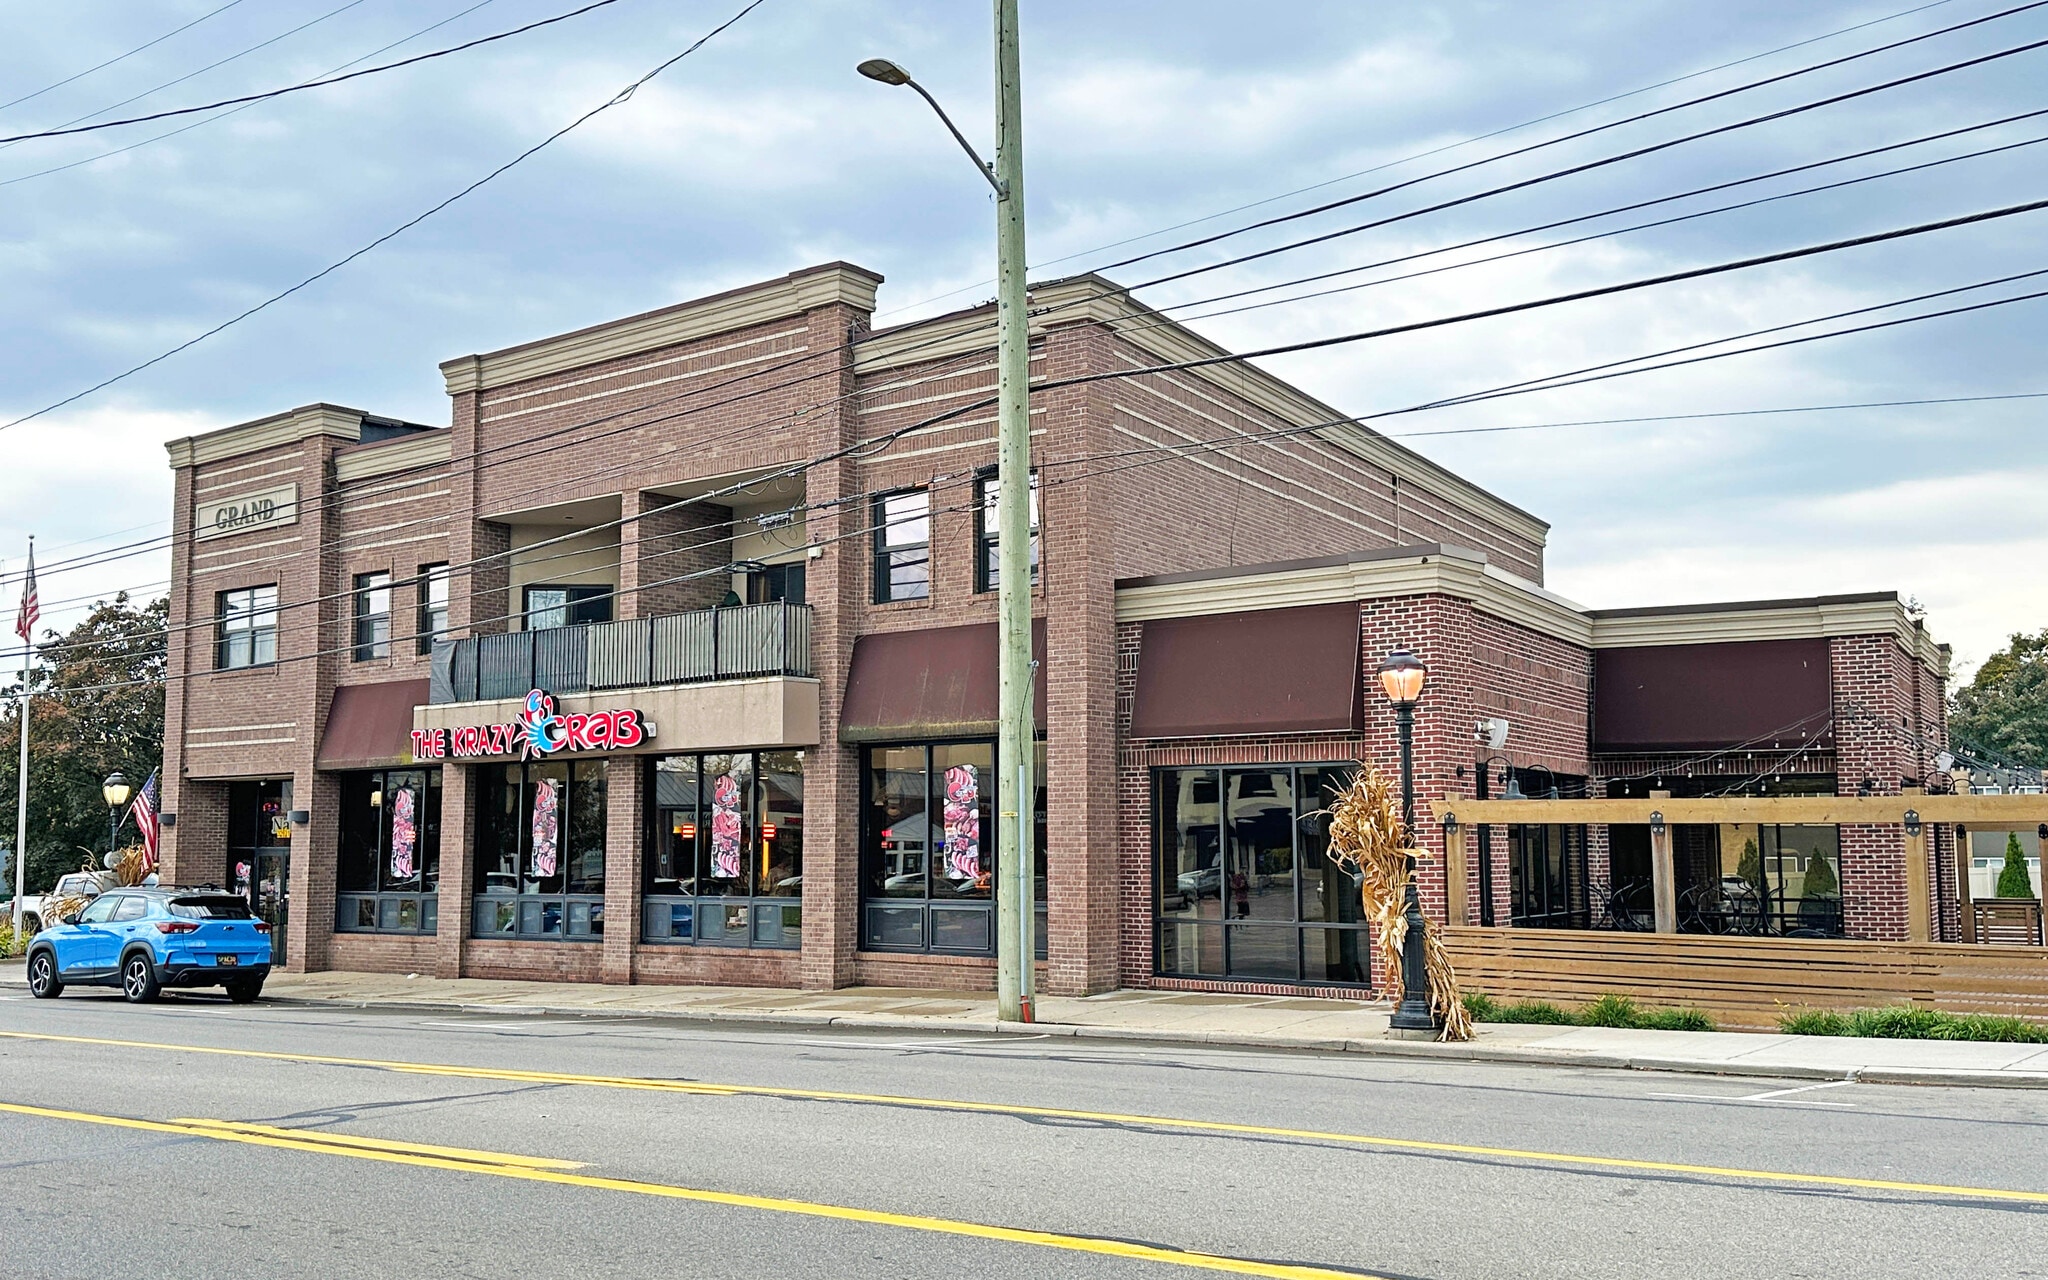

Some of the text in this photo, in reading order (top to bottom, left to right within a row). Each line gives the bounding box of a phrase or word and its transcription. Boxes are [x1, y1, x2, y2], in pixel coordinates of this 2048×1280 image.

[215, 498, 275, 530] GRAND
[411, 729, 446, 759] THE
[452, 723, 516, 757] KRAZY
